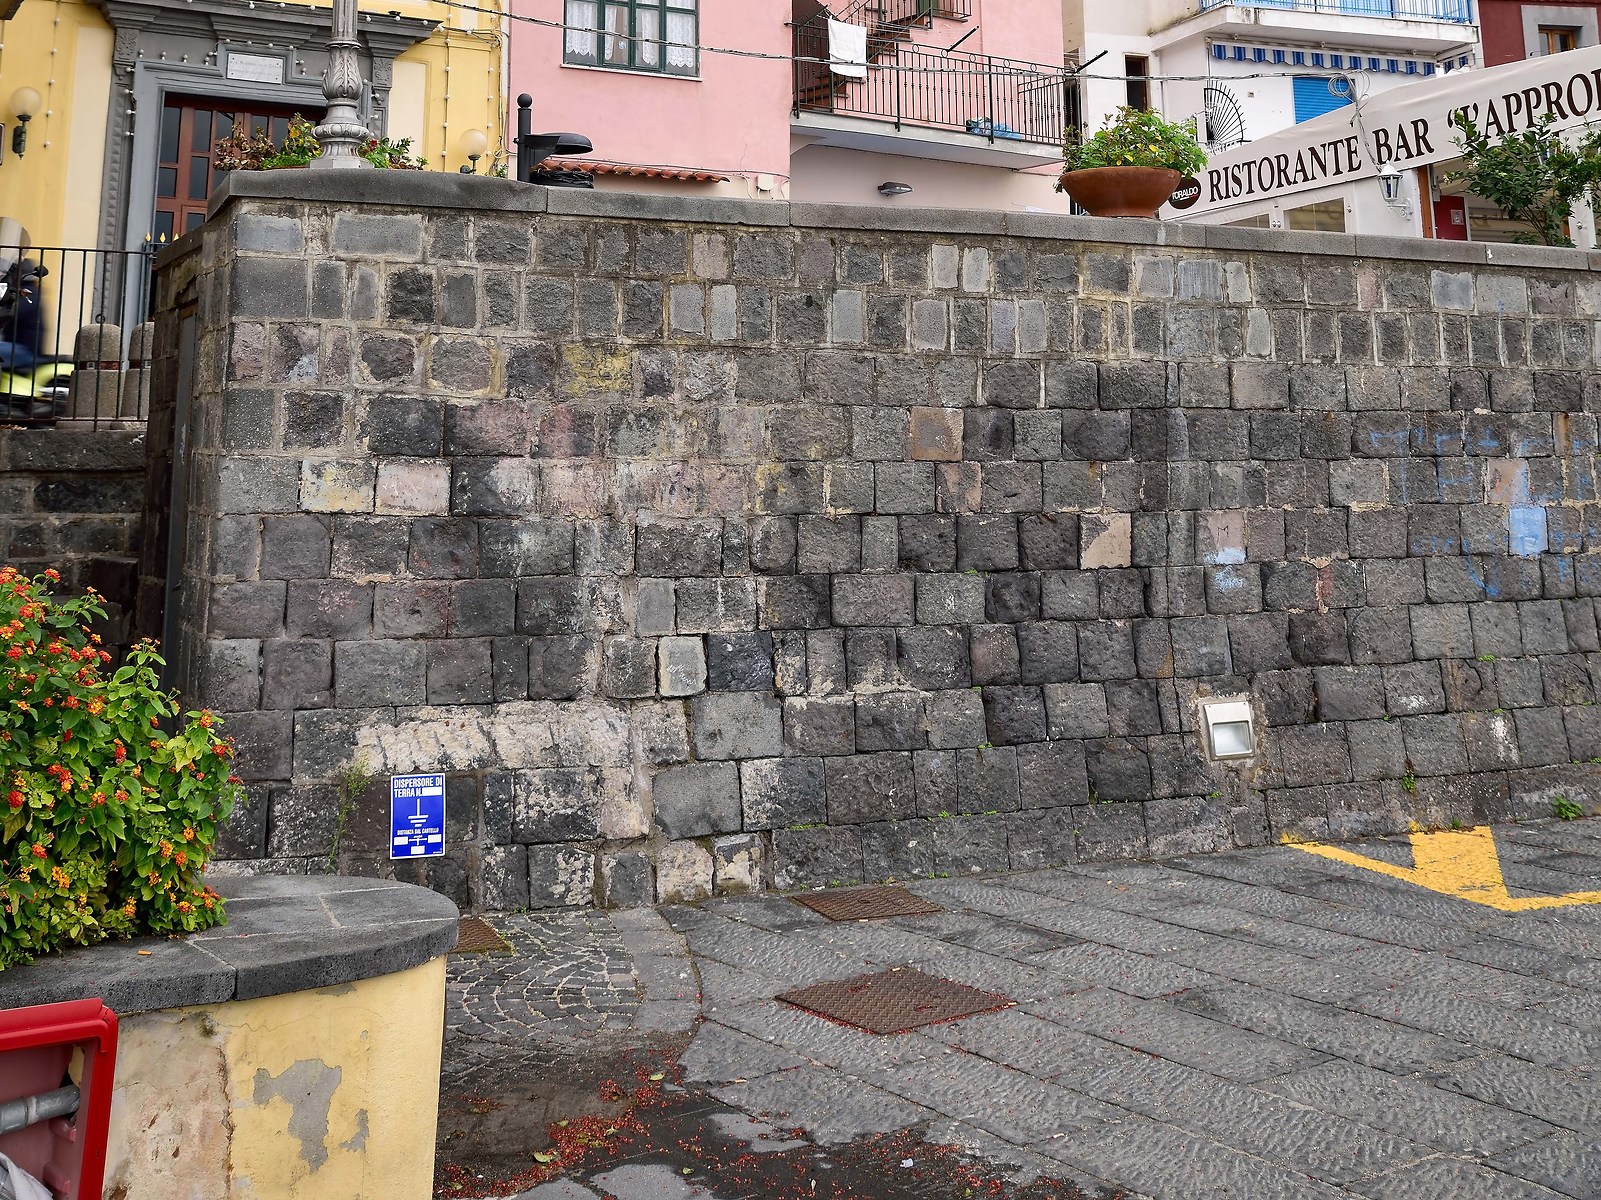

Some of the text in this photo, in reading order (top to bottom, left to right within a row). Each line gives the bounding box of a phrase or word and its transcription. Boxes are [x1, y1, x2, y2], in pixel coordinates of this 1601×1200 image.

[1208, 135, 1362, 202] RISTORANTE
[1372, 118, 1434, 165] BAR
[394, 777, 442, 788] DISPERSORE DI
[394, 788, 415, 798] TERRA
